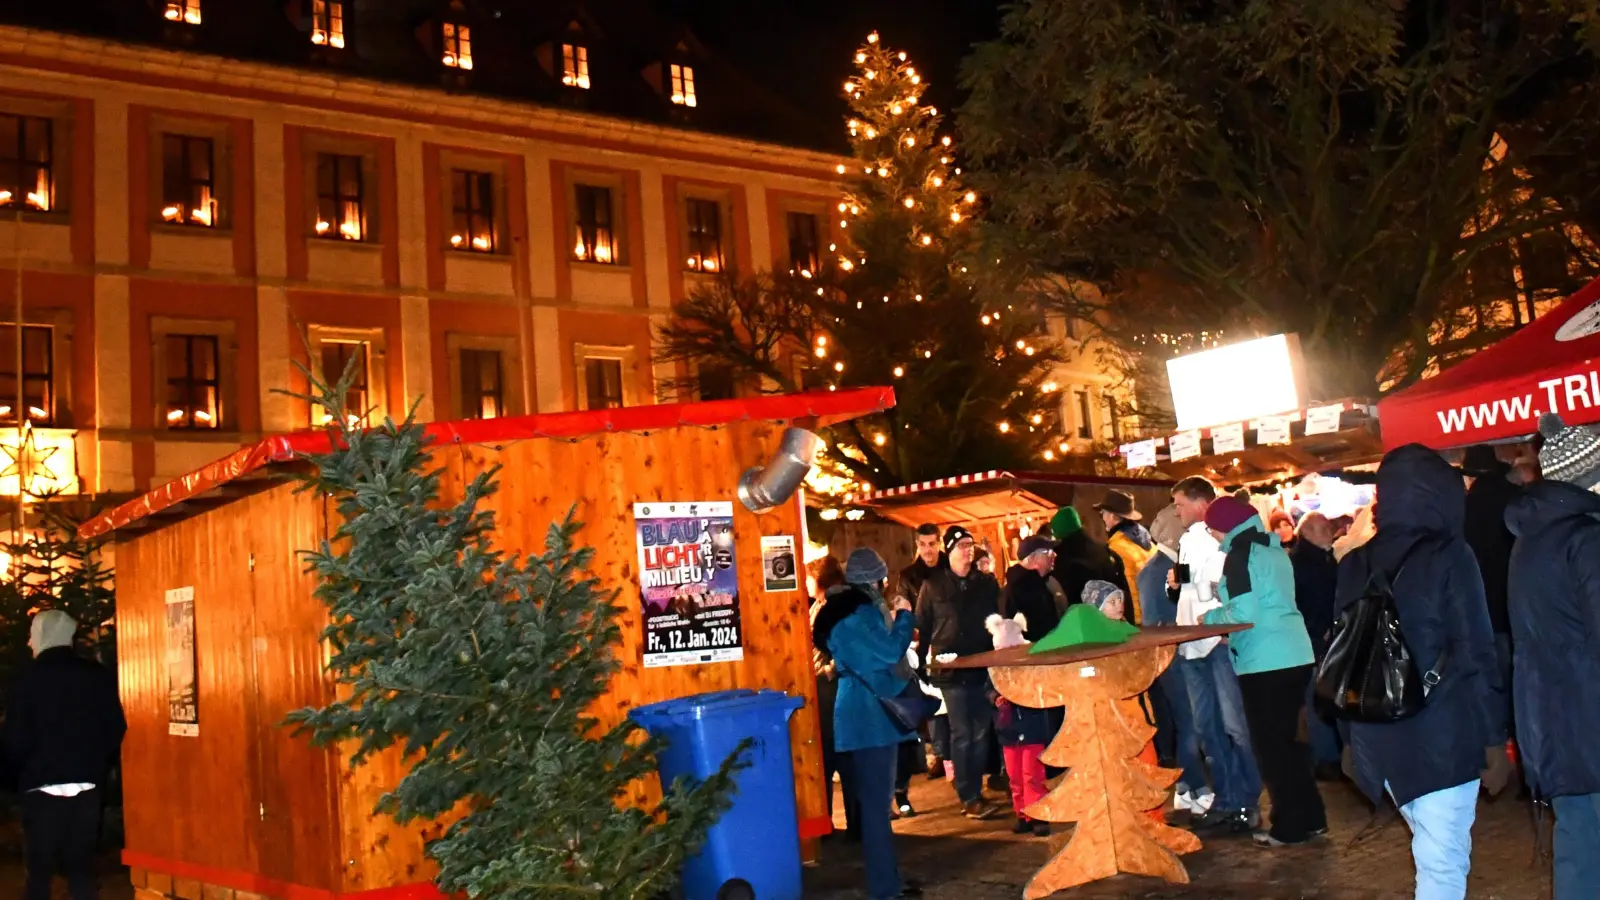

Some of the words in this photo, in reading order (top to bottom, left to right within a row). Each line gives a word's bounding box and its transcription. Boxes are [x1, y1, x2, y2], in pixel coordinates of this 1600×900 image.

[642, 520, 699, 546] BLAU
[644, 544, 700, 570] LICHT
[701, 519, 715, 580] PARTY
[648, 567, 702, 588] MILIEU
[648, 632, 666, 653] Fr.,
[669, 630, 686, 649] 12.
[687, 629, 710, 648] Jan.
[711, 627, 738, 646] 2024
